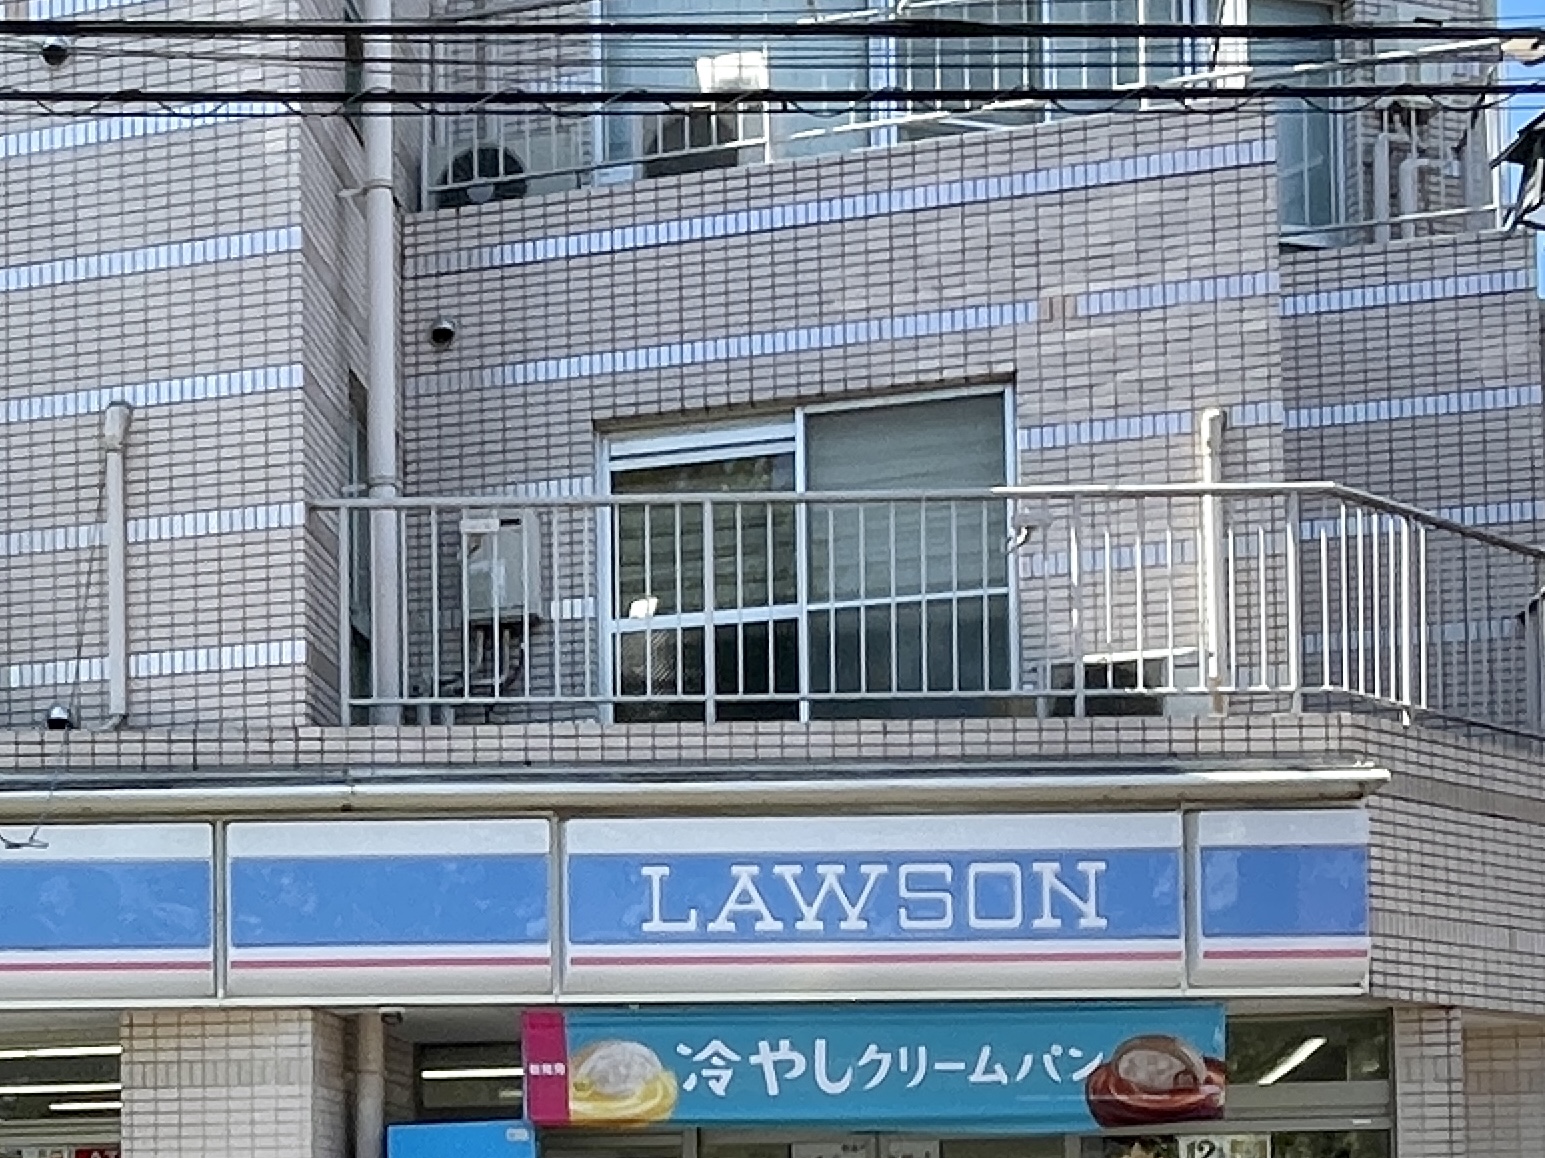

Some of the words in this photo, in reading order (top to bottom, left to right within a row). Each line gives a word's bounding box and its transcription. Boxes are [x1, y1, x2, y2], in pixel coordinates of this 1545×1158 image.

[641, 860, 1108, 933] LAWSON
[675, 1038, 1105, 1097] 冷やしクリームパン
